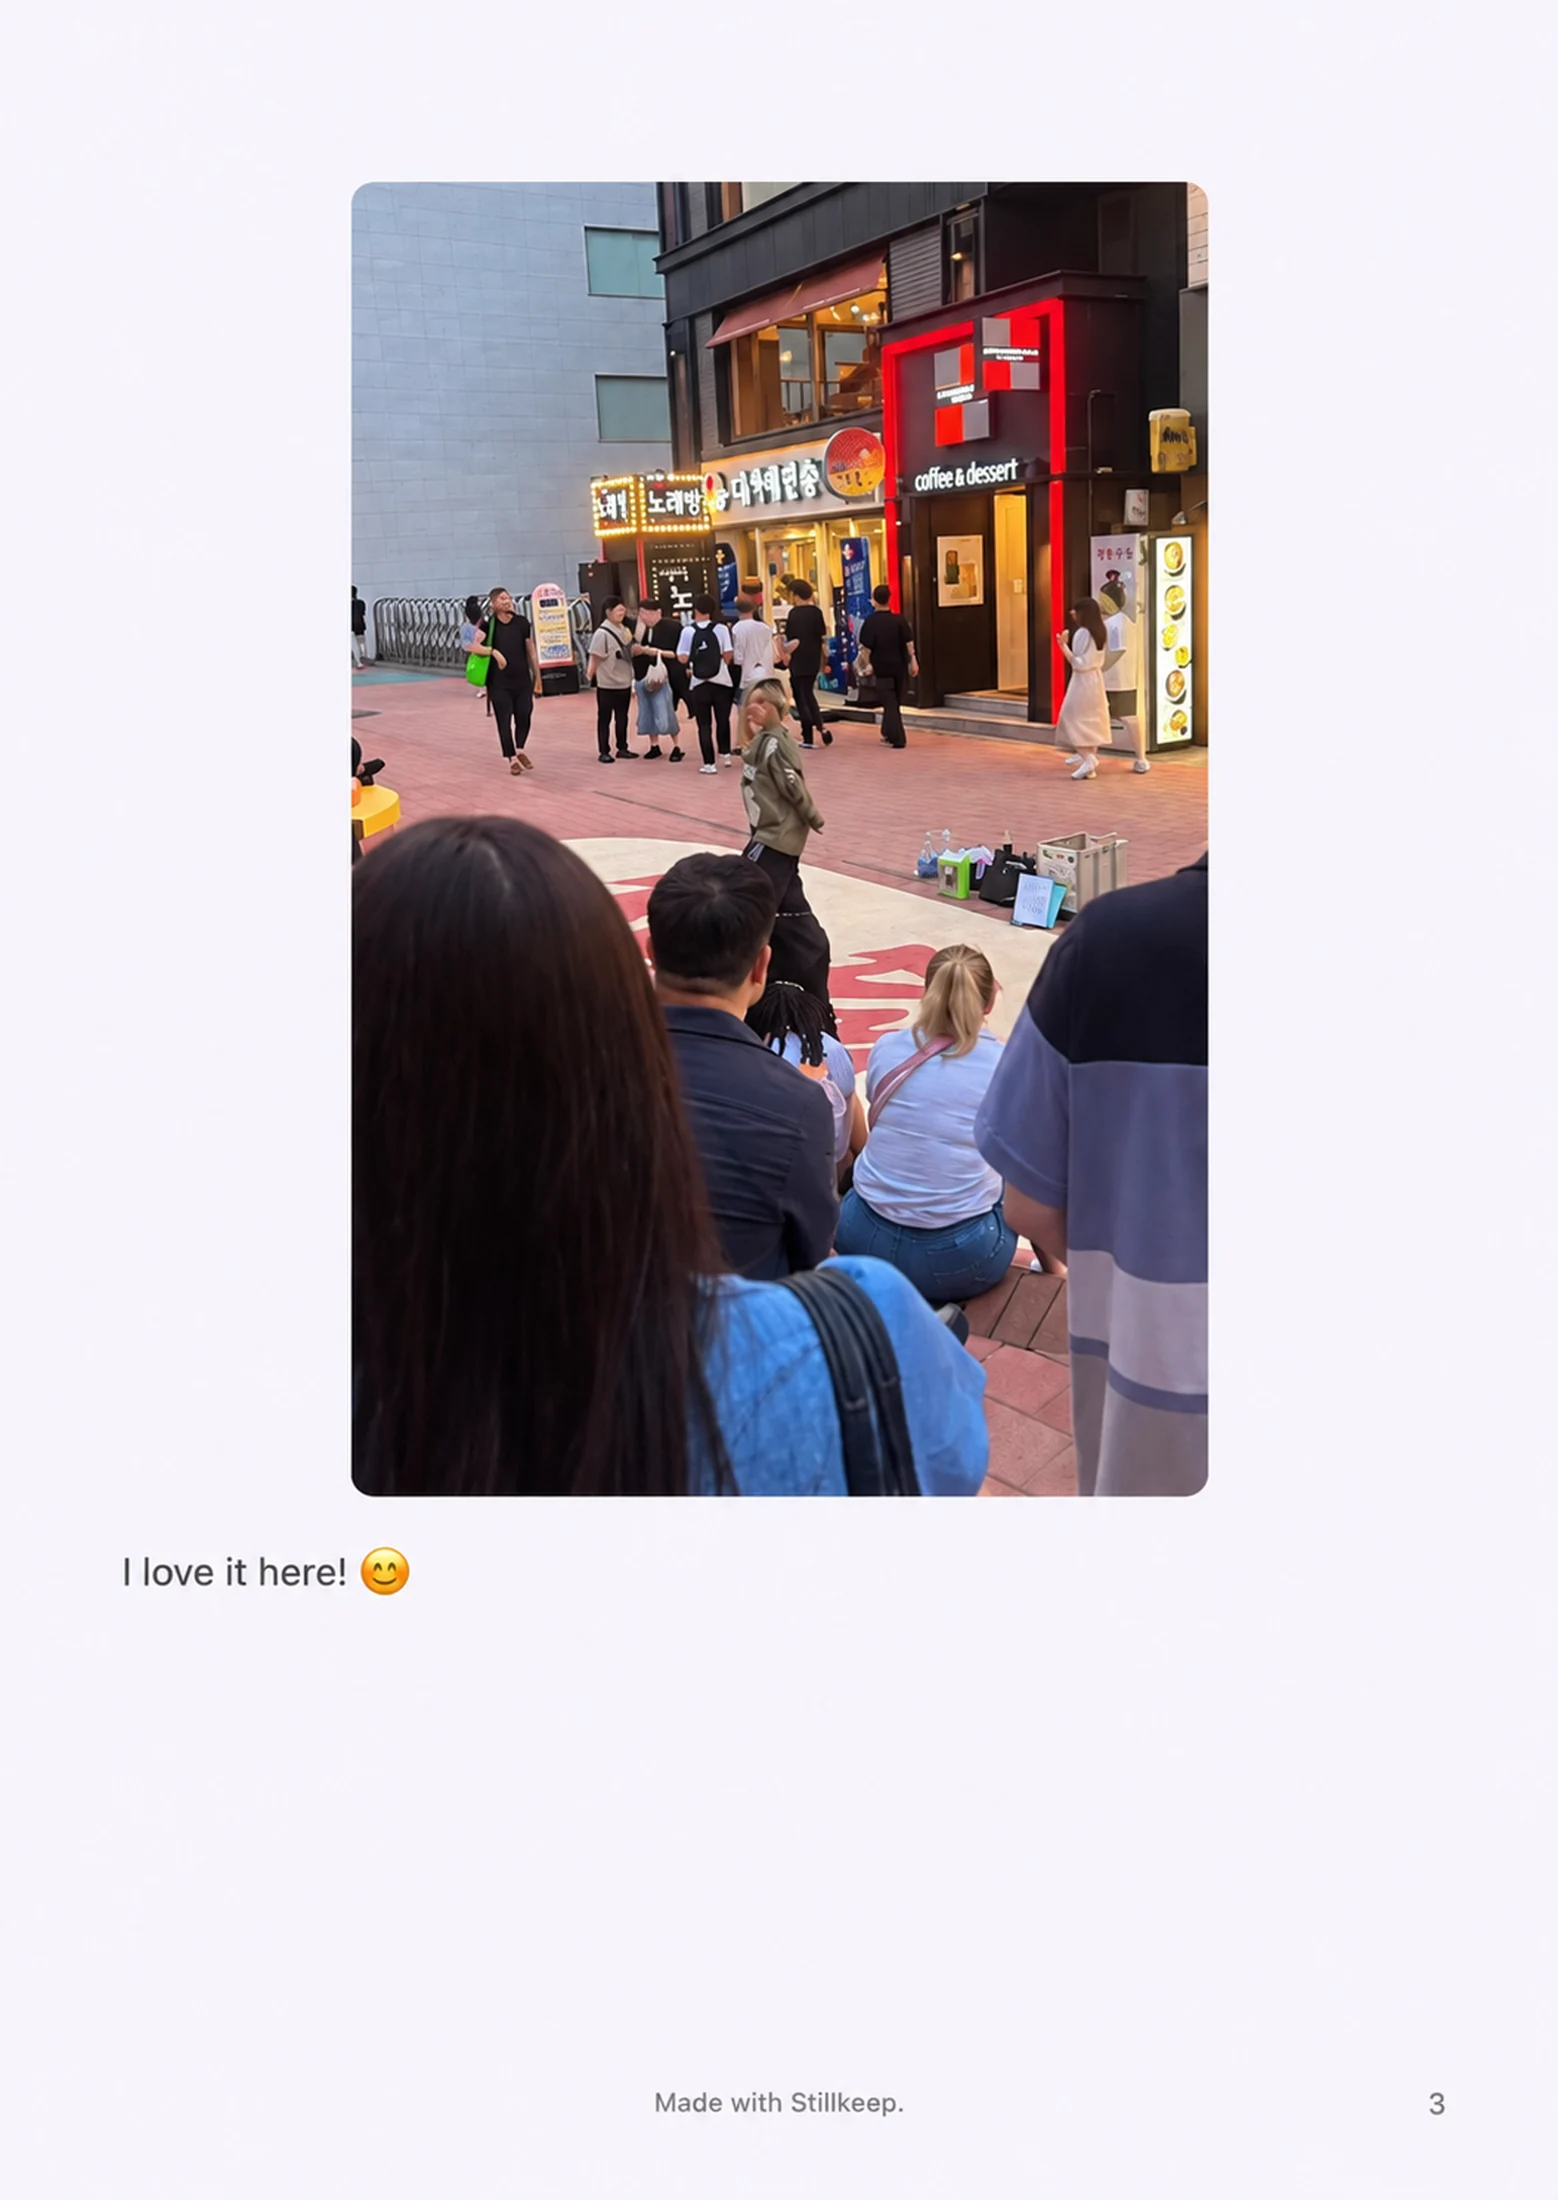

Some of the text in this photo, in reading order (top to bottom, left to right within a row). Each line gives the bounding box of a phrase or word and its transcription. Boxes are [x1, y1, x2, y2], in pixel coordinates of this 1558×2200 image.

[914, 458, 1018, 492] coffee & dessert
[647, 487, 704, 516] 노래방
